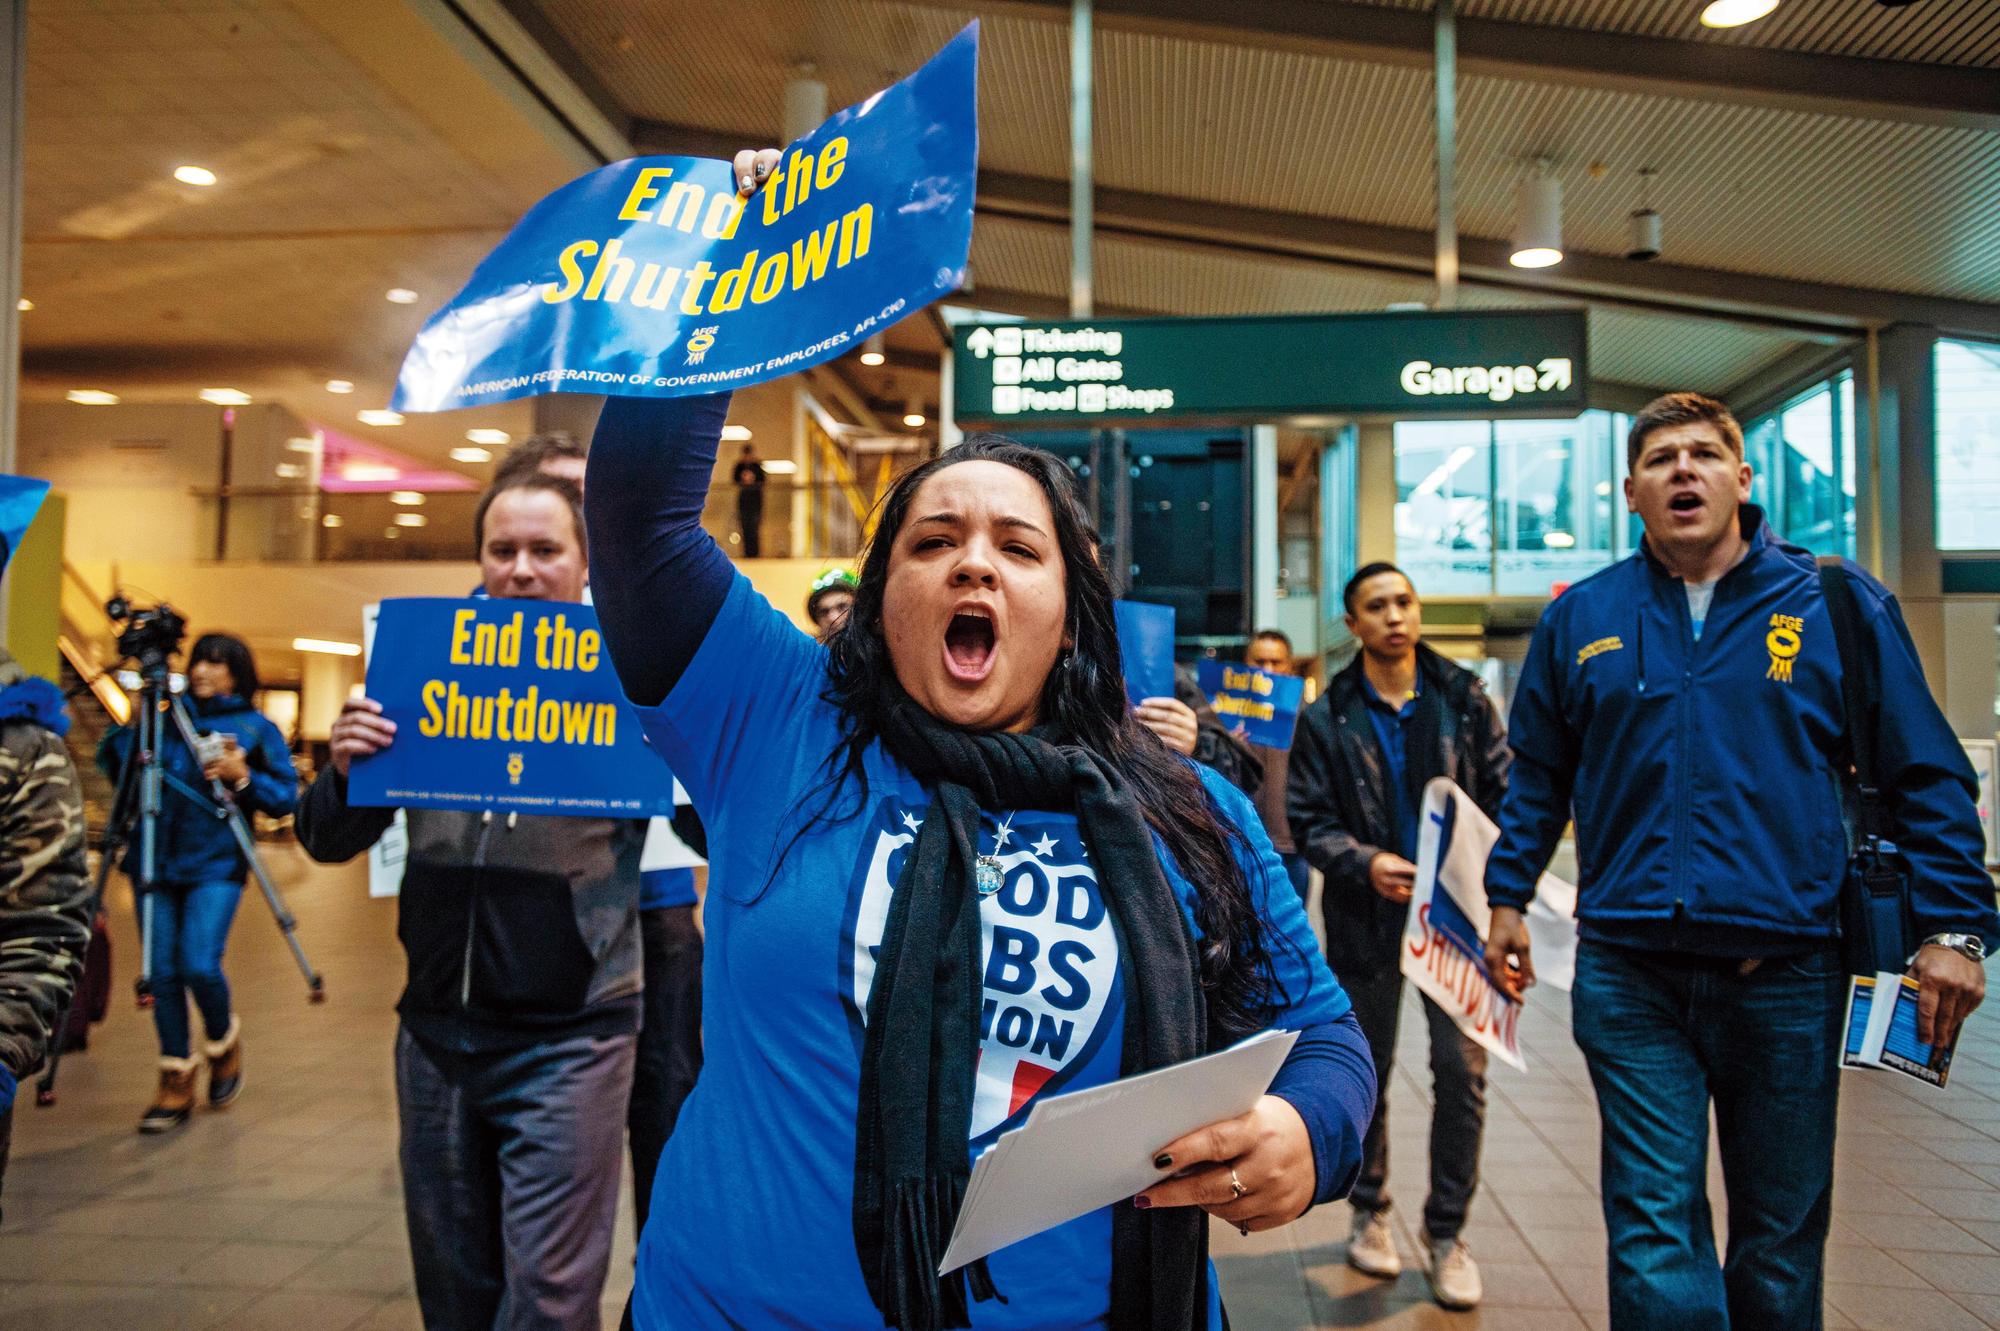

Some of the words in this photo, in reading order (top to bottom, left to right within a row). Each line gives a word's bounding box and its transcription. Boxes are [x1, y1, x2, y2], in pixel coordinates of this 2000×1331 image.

[618, 167, 748, 240] End
[762, 136, 850, 227] the
[542, 203, 874, 316] Shutdown
[692, 325, 720, 337] AFGE
[1022, 327, 1122, 356] Ticketing
[455, 375, 529, 396] AMERICAN
[531, 369, 625, 384] FEDERATION
[628, 373, 652, 385] OF
[654, 363, 764, 387] GOVERNMENT
[766, 331, 850, 370] EMPLOYEES,
[1022, 357, 1055, 382] All
[1056, 357, 1123, 381] Gates
[1400, 360, 1538, 401] Garage
[450, 609, 524, 667] End
[534, 613, 600, 672] the
[1769, 613, 1804, 633] AFGE
[419, 680, 616, 746] Shutdown
